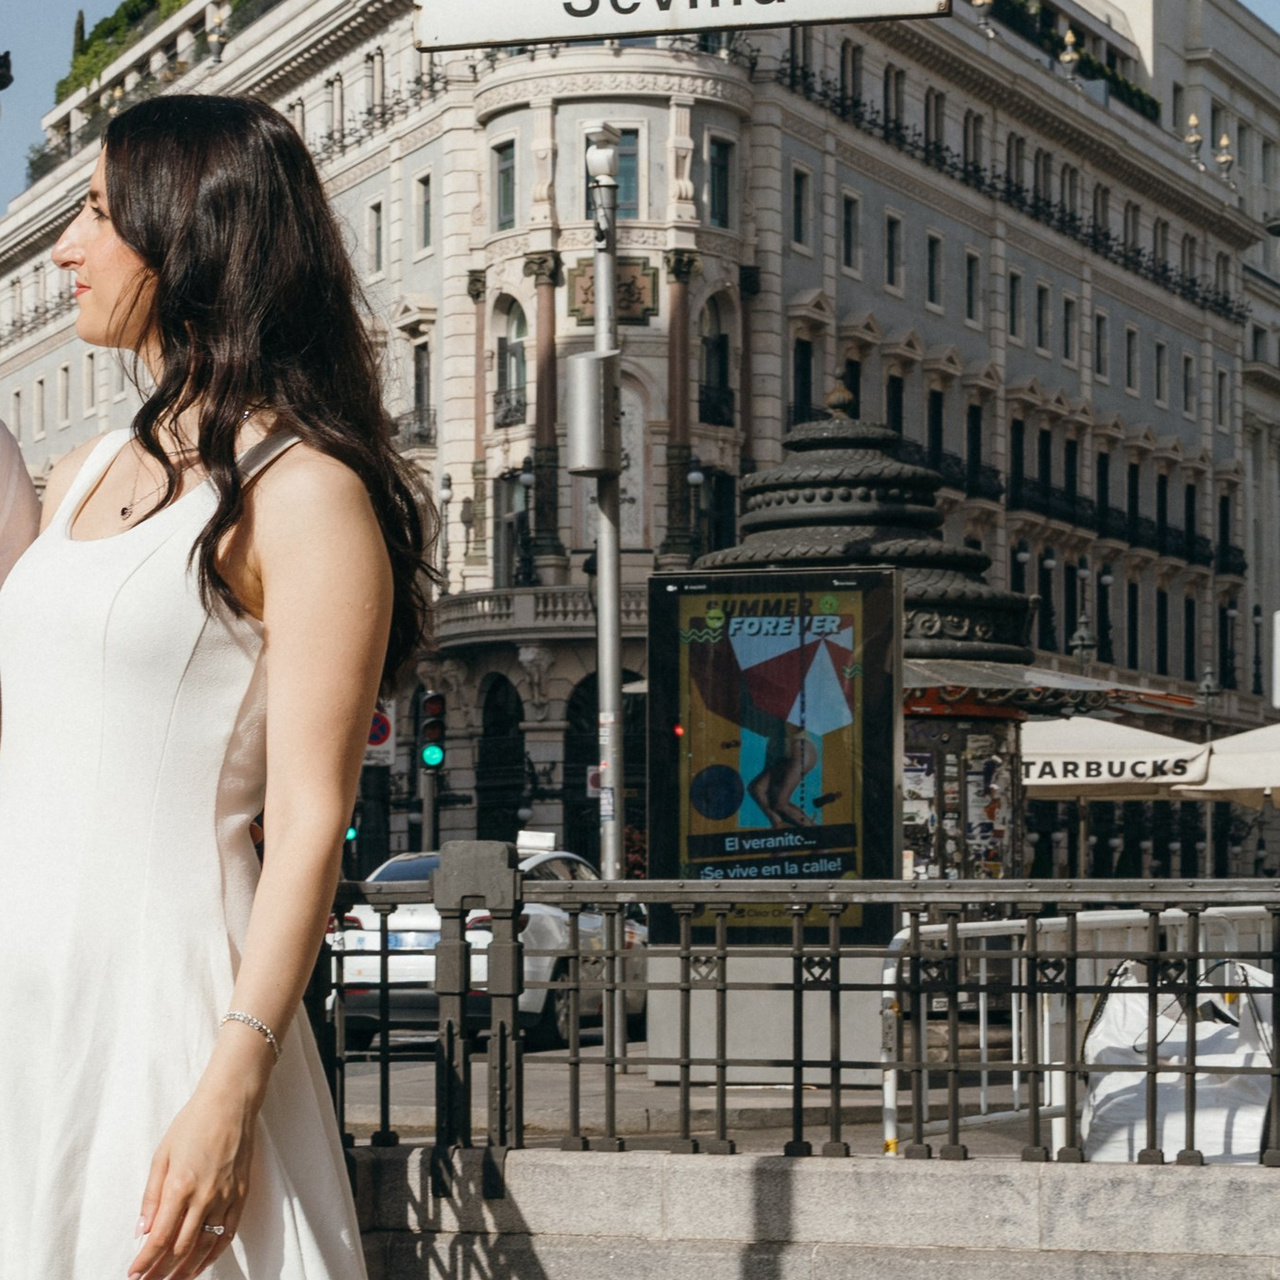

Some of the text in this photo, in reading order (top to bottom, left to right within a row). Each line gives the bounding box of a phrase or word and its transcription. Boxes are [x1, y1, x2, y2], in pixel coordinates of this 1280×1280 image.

[725, 837, 739, 851] El
[727, 864, 758, 878] vive
[761, 865, 781, 876] en
[785, 861, 798, 875] la
[802, 857, 842, 873] calle!
